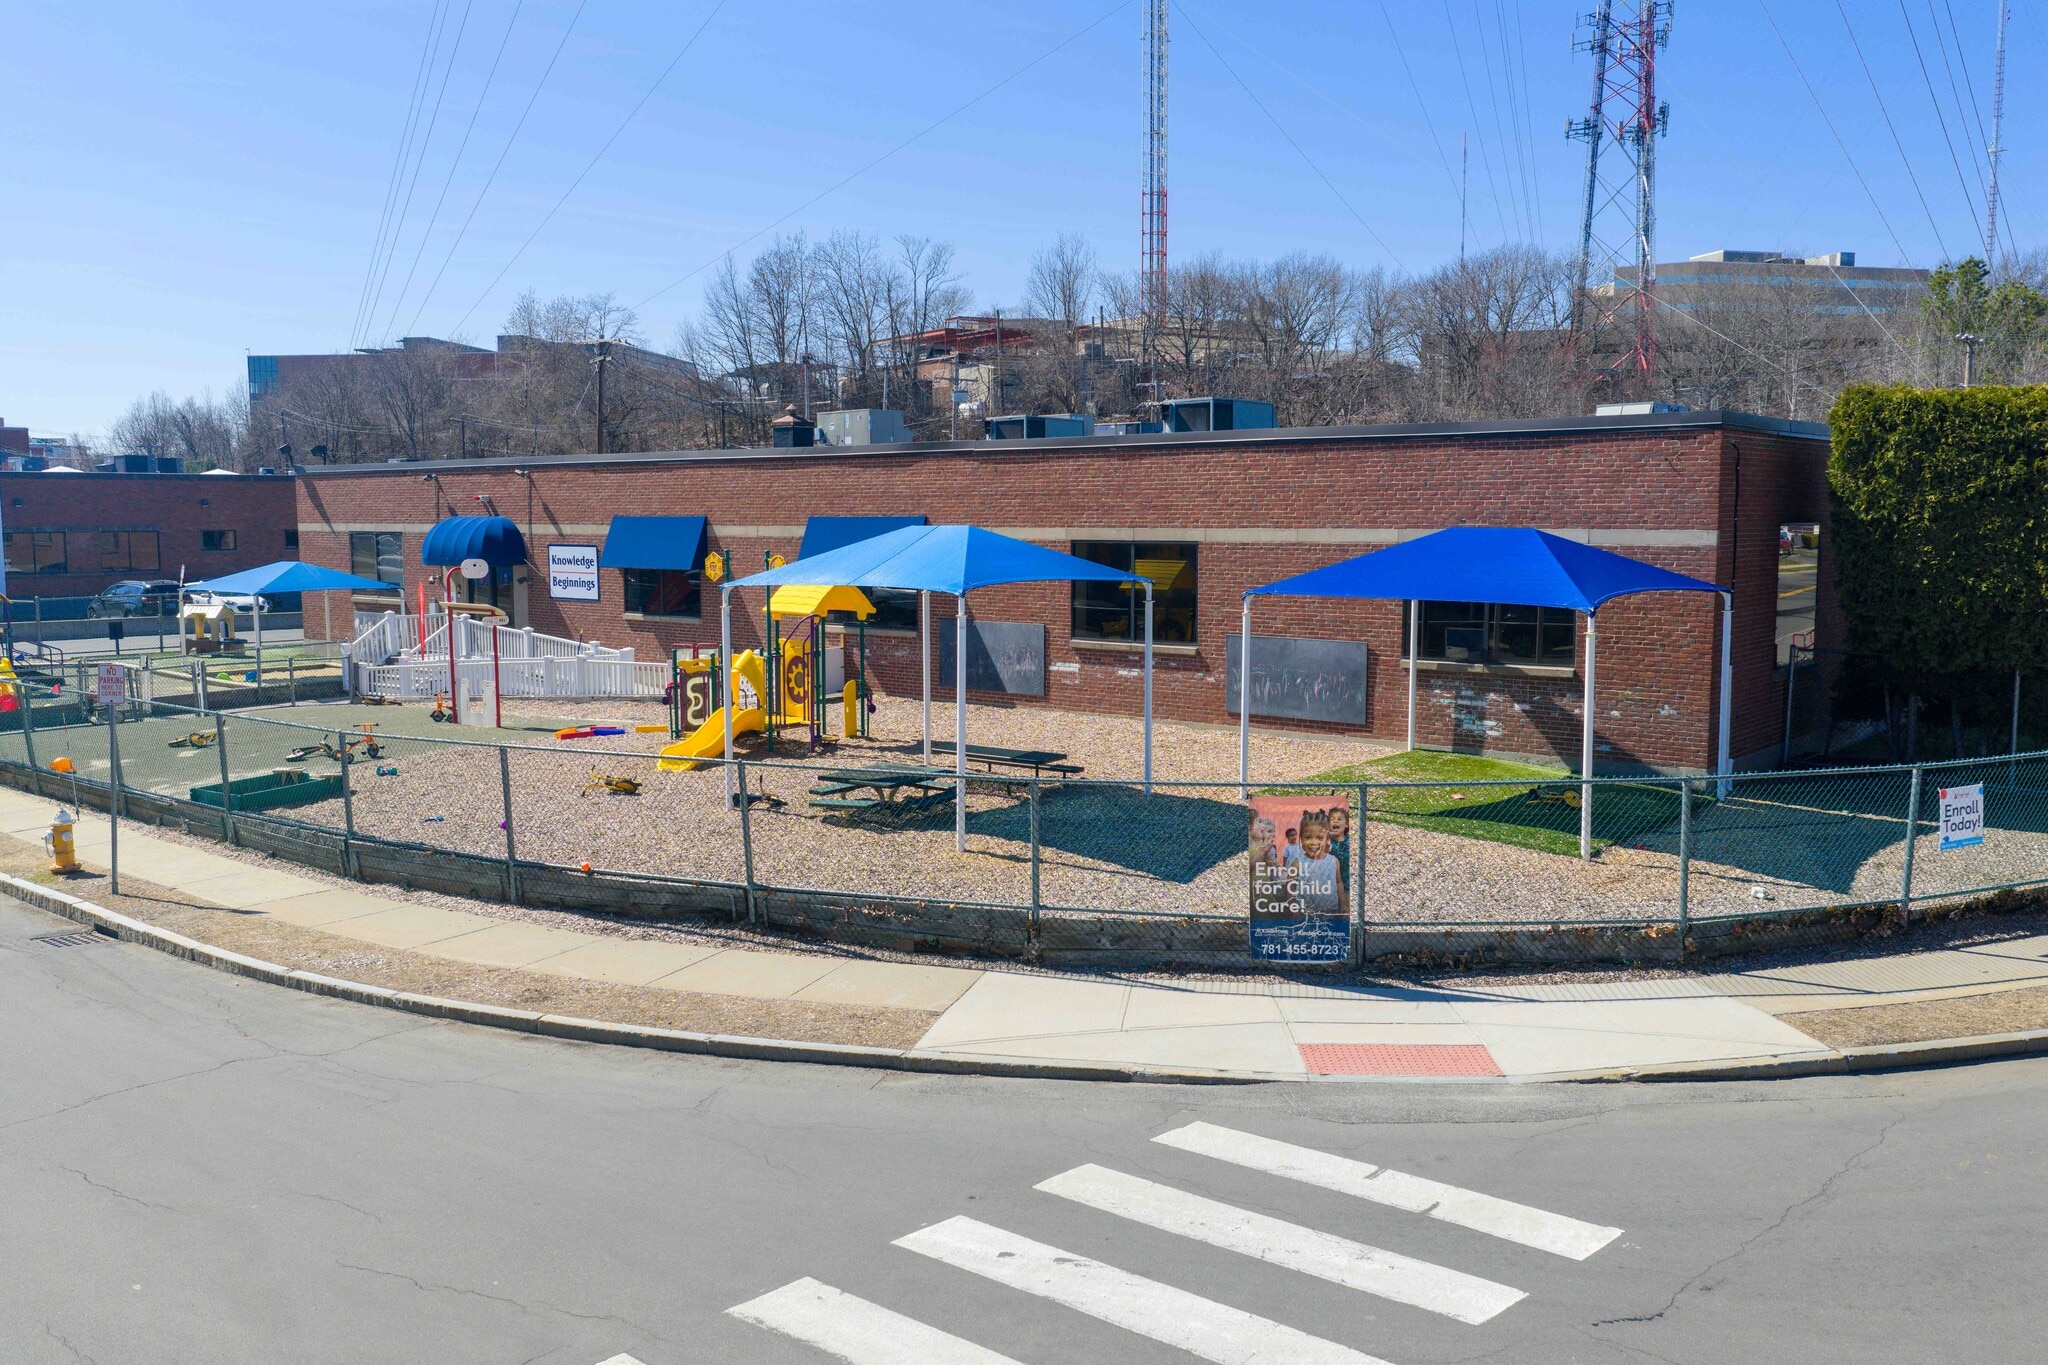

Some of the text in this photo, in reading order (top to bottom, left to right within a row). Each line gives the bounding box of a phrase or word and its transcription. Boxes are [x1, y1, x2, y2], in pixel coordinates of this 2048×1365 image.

[551, 554, 595, 569] Knowledge
[552, 576, 596, 591] Beginnings
[99, 676, 124, 684] PARKING
[1945, 800, 1979, 818] Enroll
[1943, 814, 1981, 833] Today!
[1255, 861, 1310, 877] Enroll
[1255, 879, 1331, 895] for Child
[1255, 898, 1305, 913] Care!
[1261, 945, 1339, 955] 781-455-8723
